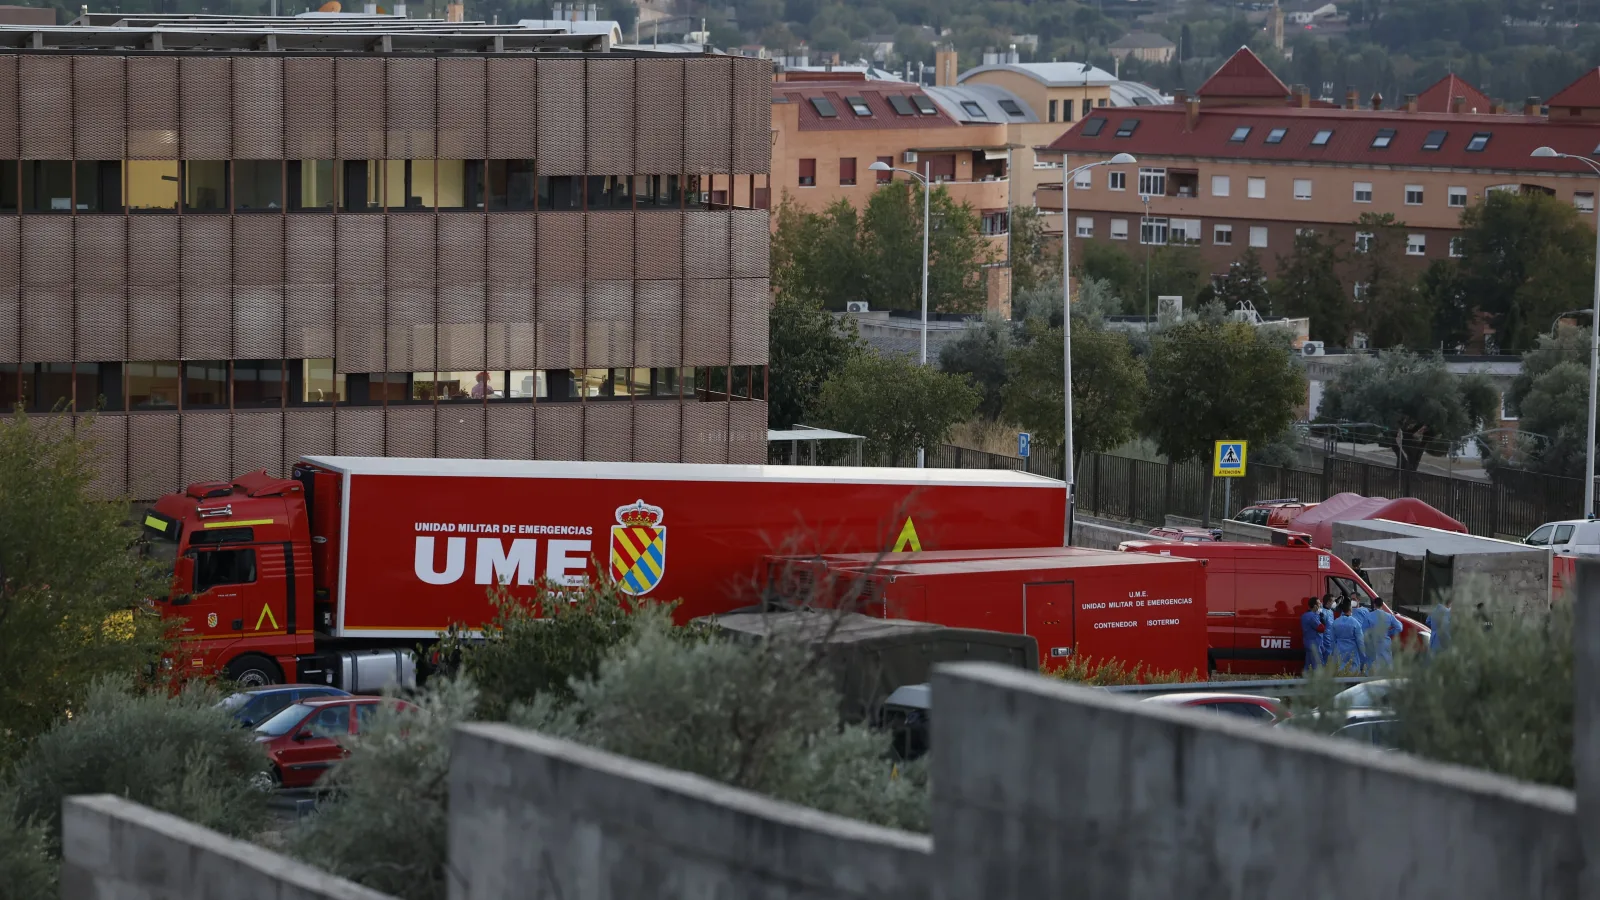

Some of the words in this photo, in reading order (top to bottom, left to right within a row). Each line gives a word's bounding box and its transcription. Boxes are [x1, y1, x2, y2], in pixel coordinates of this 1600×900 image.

[1020, 435, 1027, 454] P
[414, 522, 456, 532] UNIDAD
[457, 523, 500, 534] MILITAR
[502, 524, 516, 534] DE
[518, 525, 593, 535] EMERGENCIAS
[414, 535, 592, 587] UME
[1128, 590, 1149, 598] U.M.E.
[1081, 602, 1106, 610] UNIDAD
[1147, 597, 1193, 607] EMERGENCIAS
[1093, 620, 1138, 629] CONTENEDOR
[1146, 618, 1180, 627] ISOTERMO
[1260, 638, 1292, 649] UME
